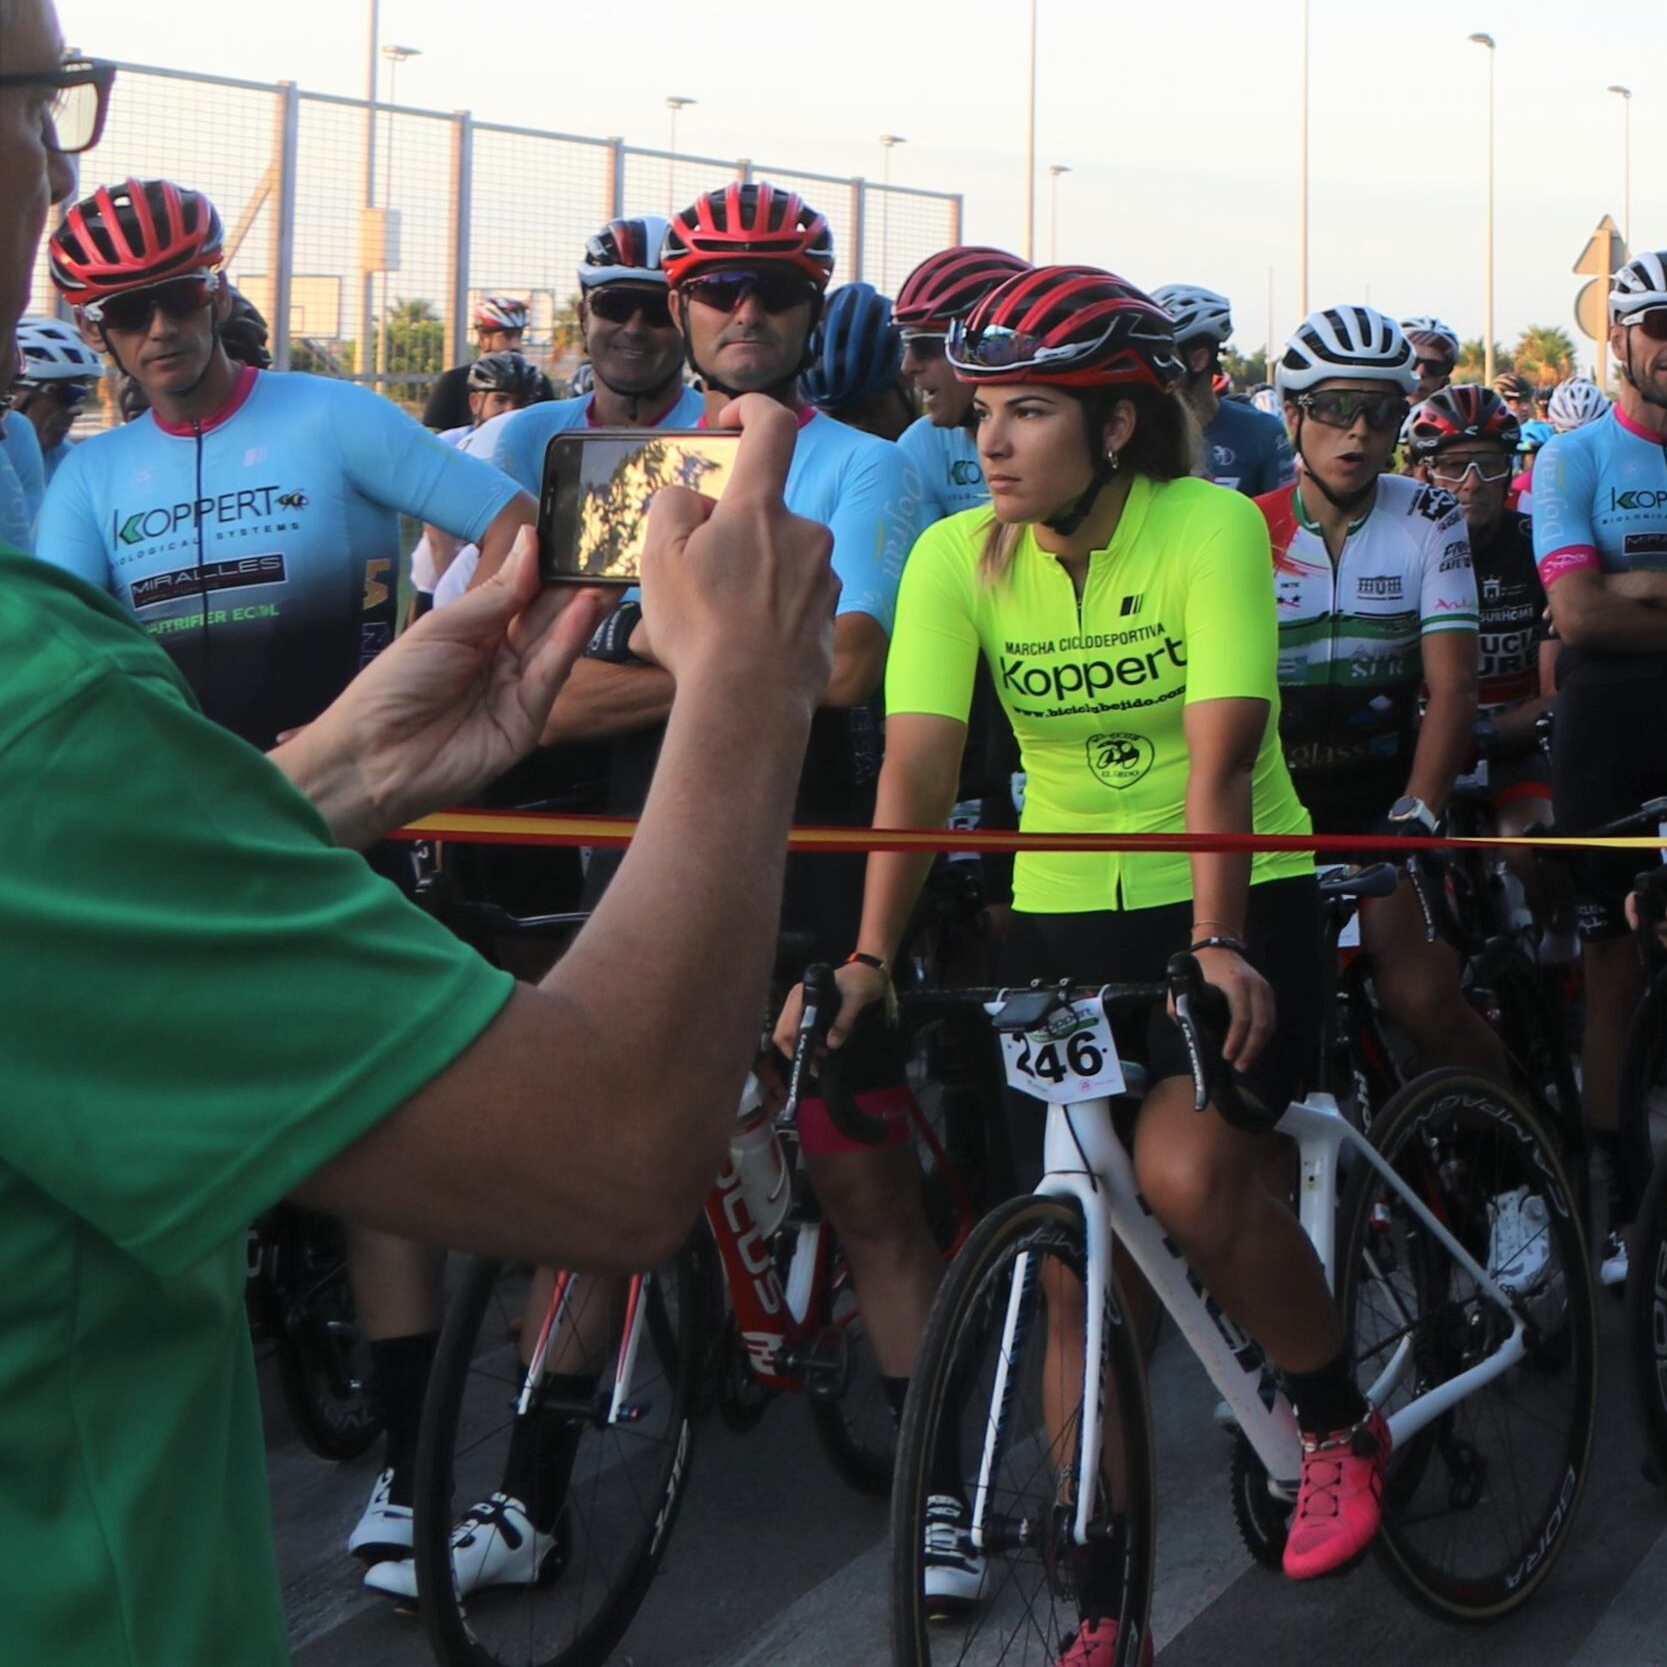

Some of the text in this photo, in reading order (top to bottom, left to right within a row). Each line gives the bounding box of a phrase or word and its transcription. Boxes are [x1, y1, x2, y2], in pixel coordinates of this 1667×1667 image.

[112, 485, 280, 551] KOPPERT
[217, 521, 301, 540] SYSTEMS
[132, 555, 283, 596] MIRALLES
[1005, 622, 1166, 657] MARCHA CICLODEPORTIVA
[1000, 637, 1188, 701] Koppert
[1011, 1030, 1104, 1084] 246
